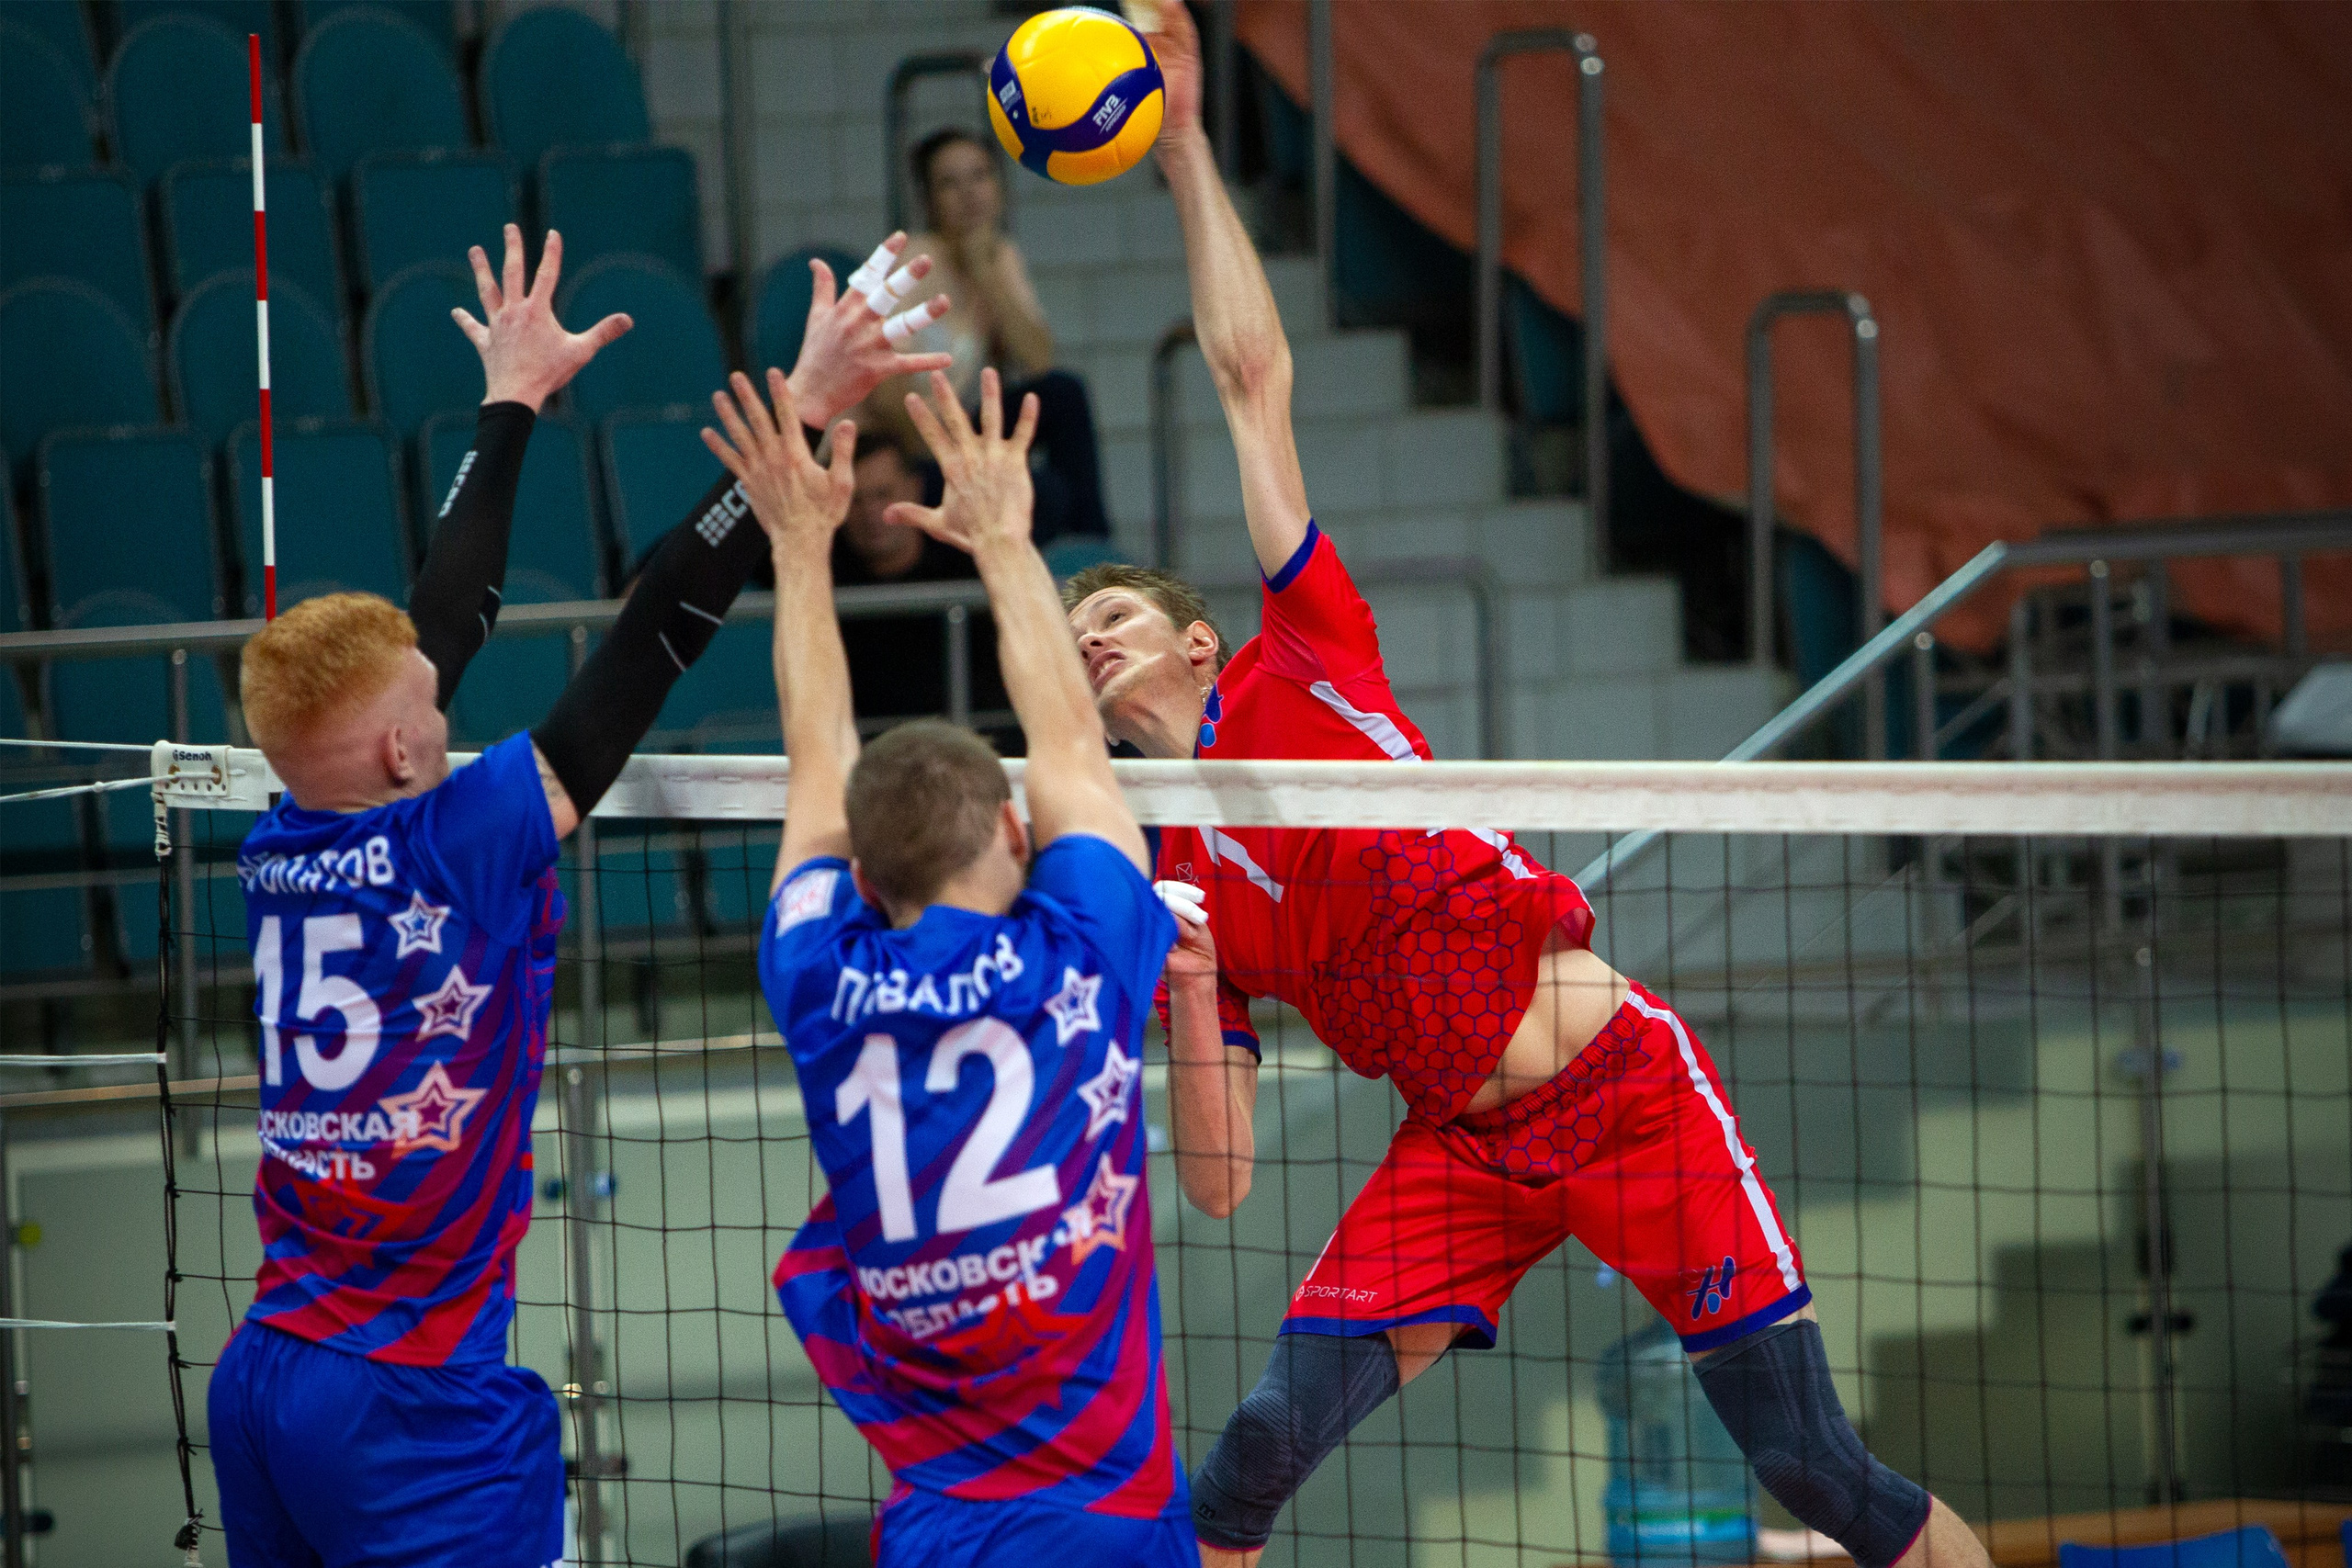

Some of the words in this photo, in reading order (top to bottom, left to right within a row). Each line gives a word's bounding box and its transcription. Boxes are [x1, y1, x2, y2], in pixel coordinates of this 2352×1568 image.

[1092, 94, 1121, 126] FIVB
[178, 751, 212, 761] Senoh
[254, 913, 381, 1091] 15
[835, 1015, 1061, 1244] 12
[1305, 1285, 1378, 1303] SPORTART
